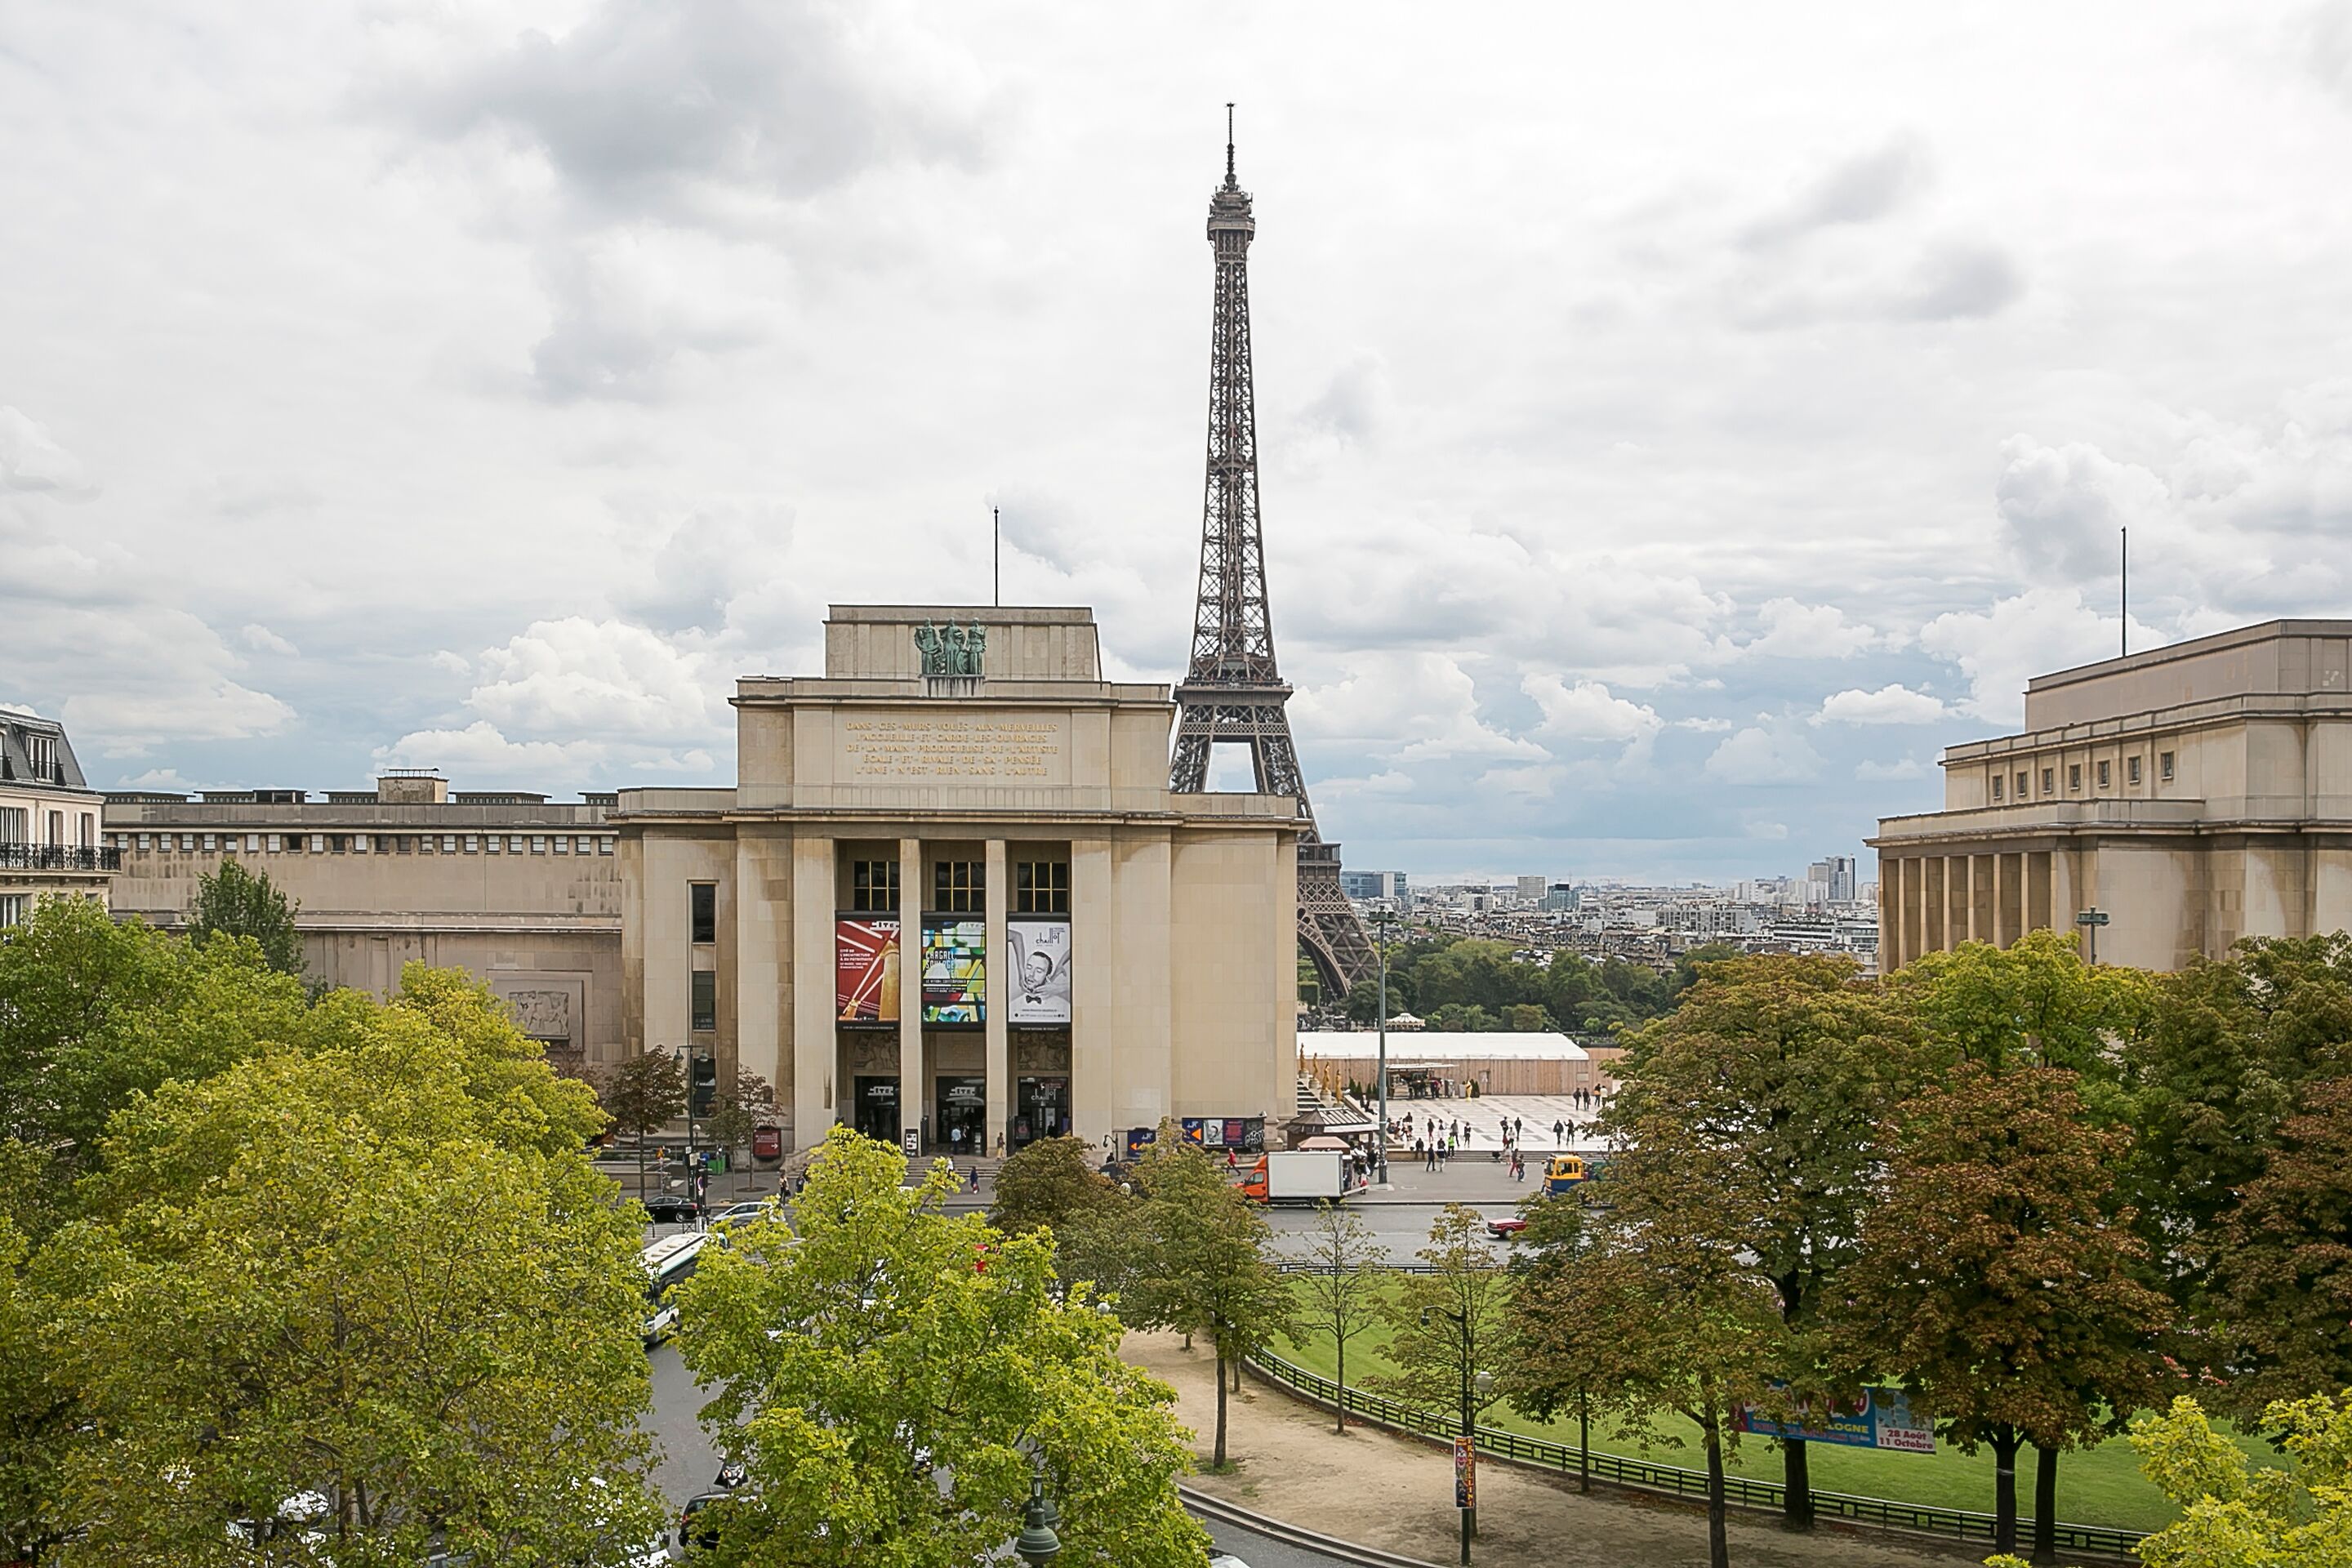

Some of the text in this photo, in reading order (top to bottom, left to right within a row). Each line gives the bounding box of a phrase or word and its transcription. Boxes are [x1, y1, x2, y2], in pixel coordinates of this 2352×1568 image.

[879, 723, 896, 731] CES
[902, 723, 931, 731] MURS
[976, 724, 993, 732] AUX
[1000, 724, 1058, 733] MERVEILLES
[920, 734, 930, 742] ET
[937, 734, 969, 742] GARDE
[975, 734, 991, 743] LES
[996, 734, 1047, 743] OUVRAGES
[846, 744, 859, 752] DE
[917, 745, 984, 753] PRODIGIEUSE
[991, 746, 1003, 754] DE
[1010, 746, 1058, 754] L'ARTISTE
[902, 755, 913, 764] ET
[922, 755, 954, 764] RIVALE
[962, 756, 975, 764] DE
[983, 756, 996, 764] SA
[856, 766, 1047, 776] L'UNE N'EST RIEN SANS L'AUTRE
[1887, 1429, 1927, 1440] 28 Août
[1879, 1437, 1891, 1446] 11
[1895, 1438, 1934, 1450] Octobre
